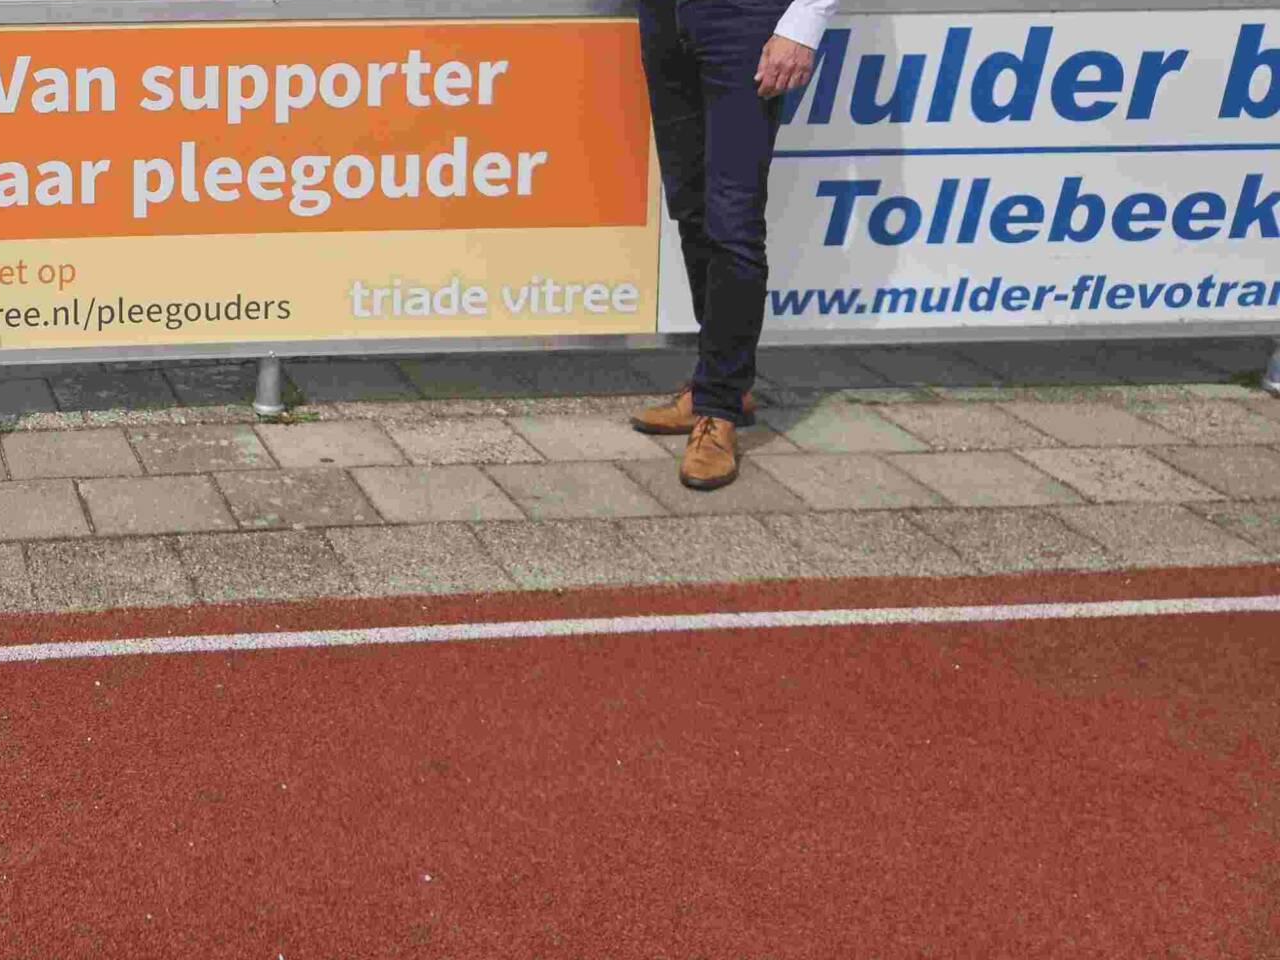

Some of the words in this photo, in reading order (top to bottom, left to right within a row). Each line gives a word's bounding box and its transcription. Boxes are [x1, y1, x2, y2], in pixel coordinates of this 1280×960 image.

[140, 49, 509, 123] supporter
[780, 24, 1188, 125] Mulder
[133, 138, 549, 218] pleegouder
[816, 173, 1280, 246] Tollebeek
[38, 263, 77, 291] op
[349, 275, 488, 317] triade
[501, 275, 640, 313] vitree
[766, 273, 1280, 316] ww.mulder-flevotra
